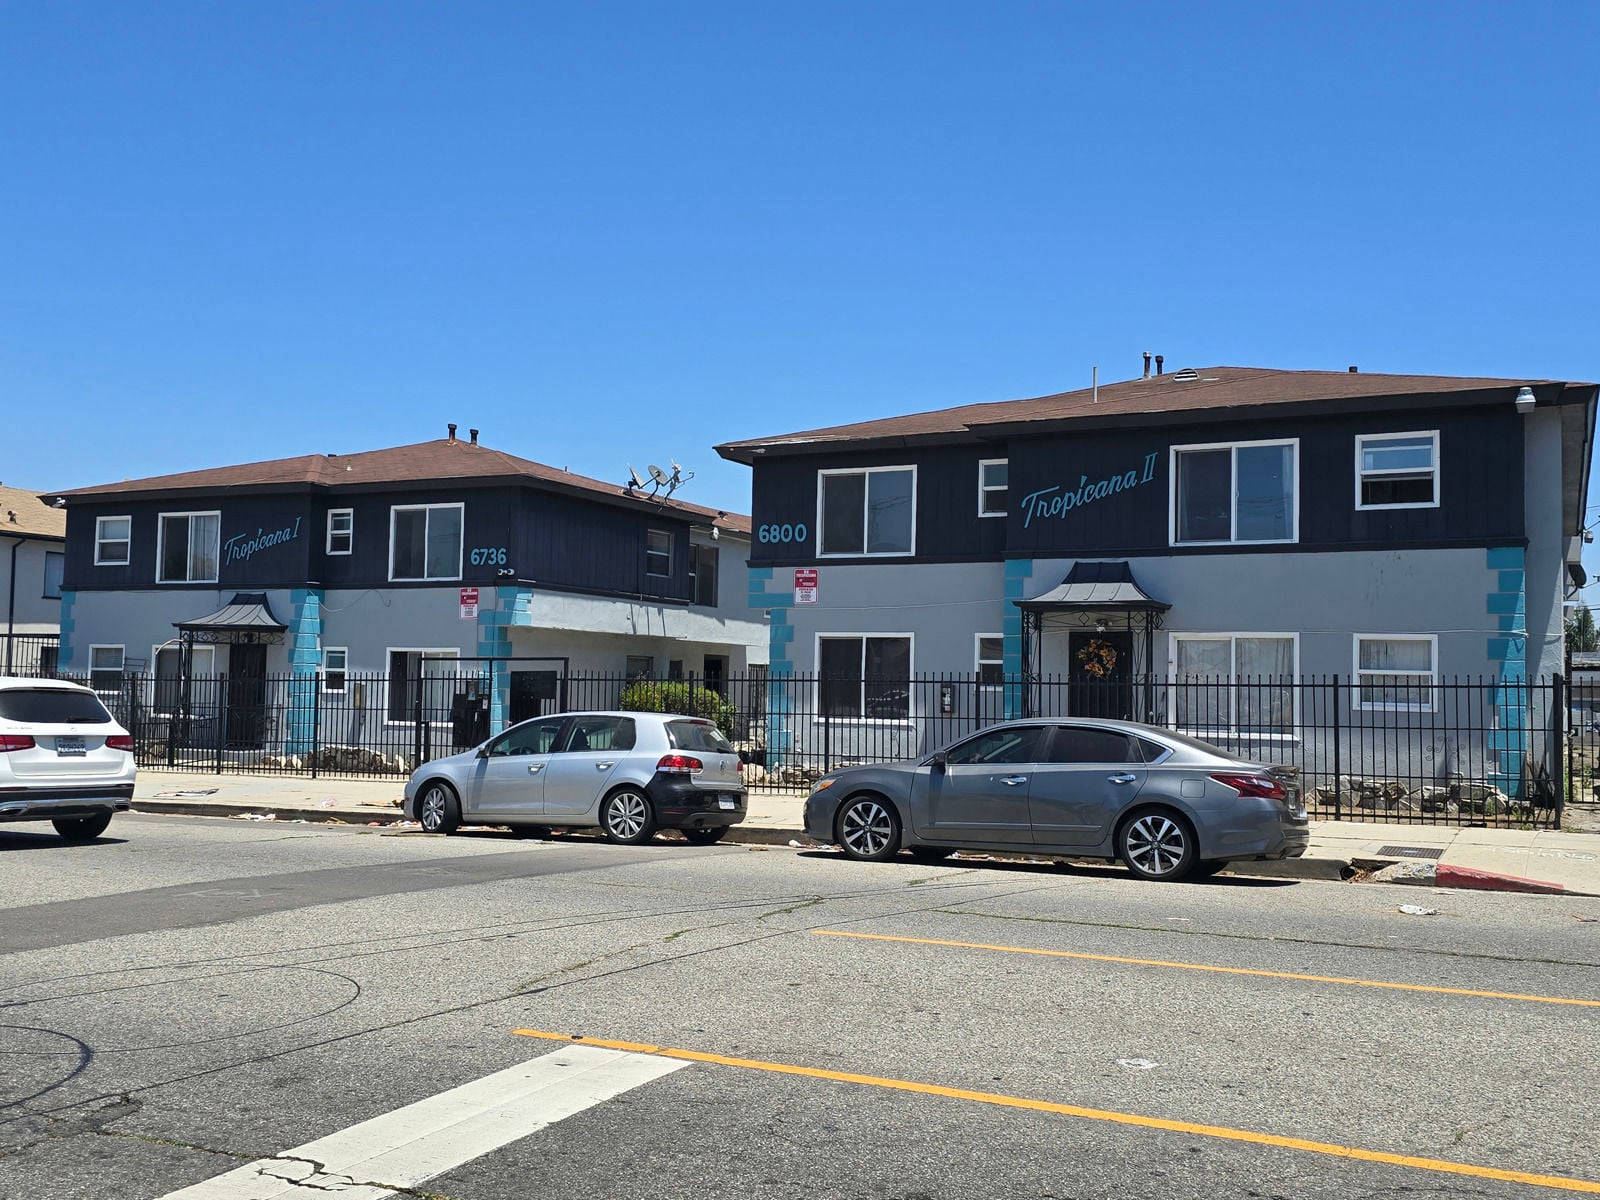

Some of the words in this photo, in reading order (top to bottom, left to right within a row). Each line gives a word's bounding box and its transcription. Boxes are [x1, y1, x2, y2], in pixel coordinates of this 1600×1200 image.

[1021, 470, 1137, 529] Tropicana
[1140, 451, 1159, 484] II
[224, 527, 292, 566] Tropicana
[292, 516, 303, 538] I
[758, 523, 807, 543] 6800
[470, 547, 507, 566] 6736
